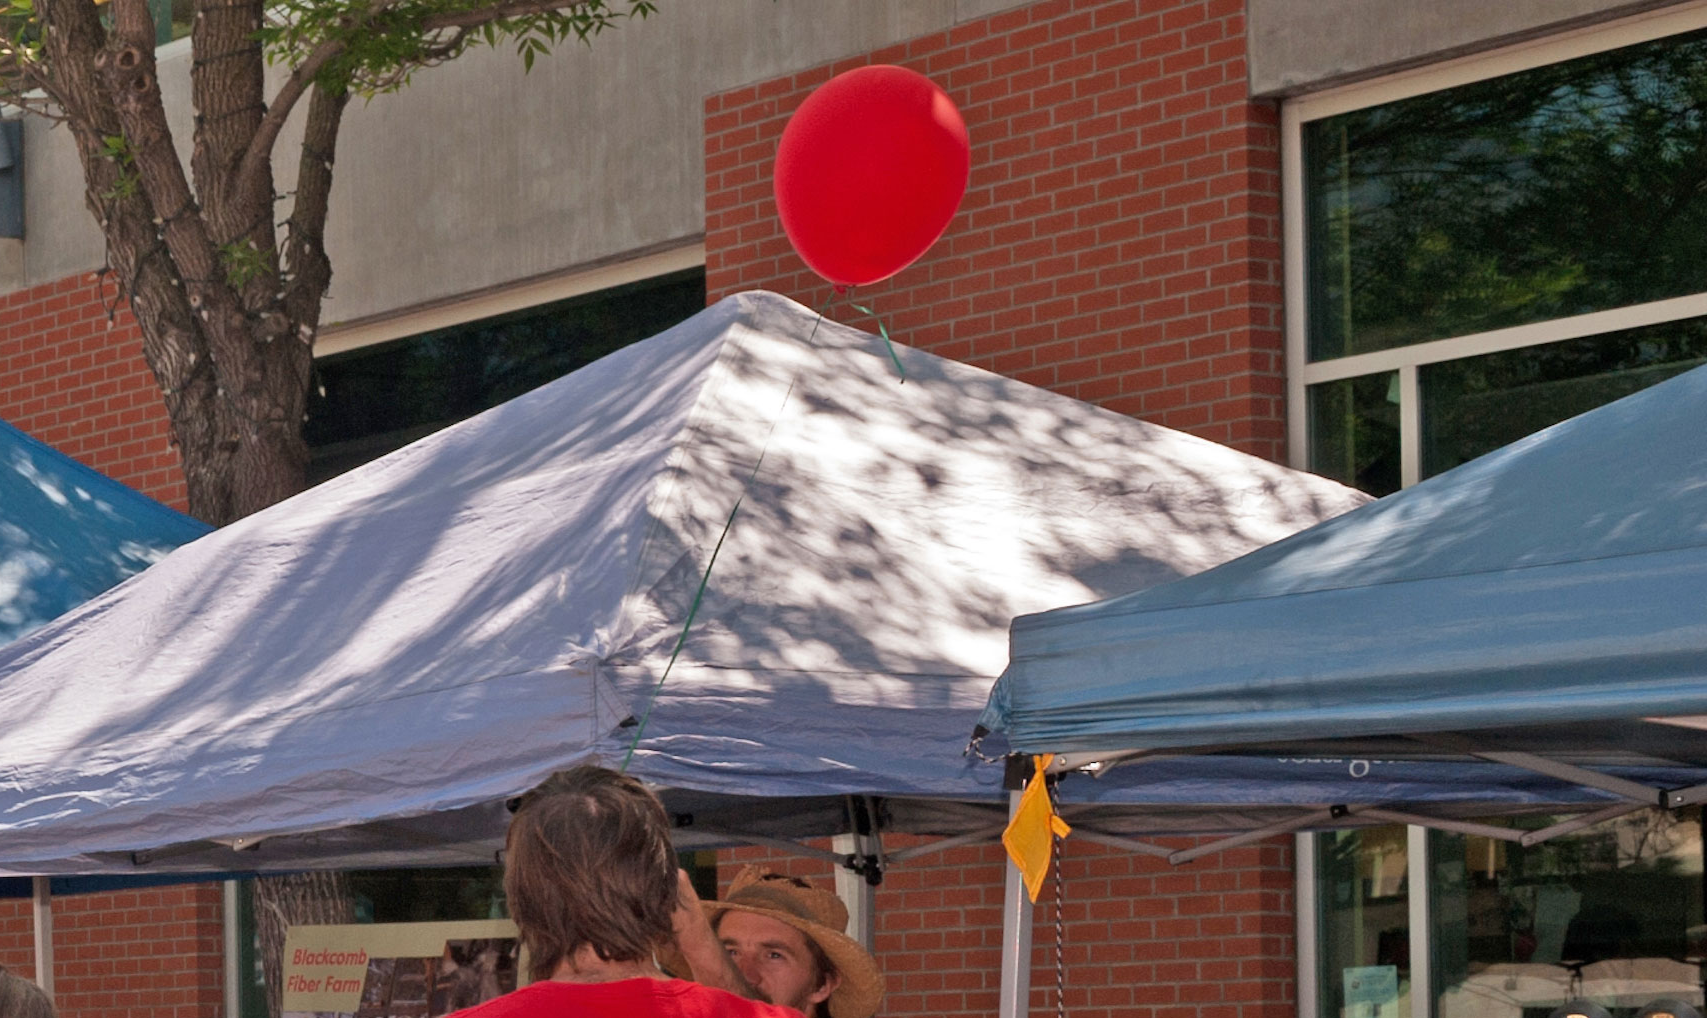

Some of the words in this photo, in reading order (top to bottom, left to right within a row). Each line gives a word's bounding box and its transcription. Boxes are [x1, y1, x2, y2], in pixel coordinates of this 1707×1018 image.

[292, 947, 367, 966] Blackcomb
[288, 975, 321, 993] Fiber
[325, 975, 361, 993] Farm
